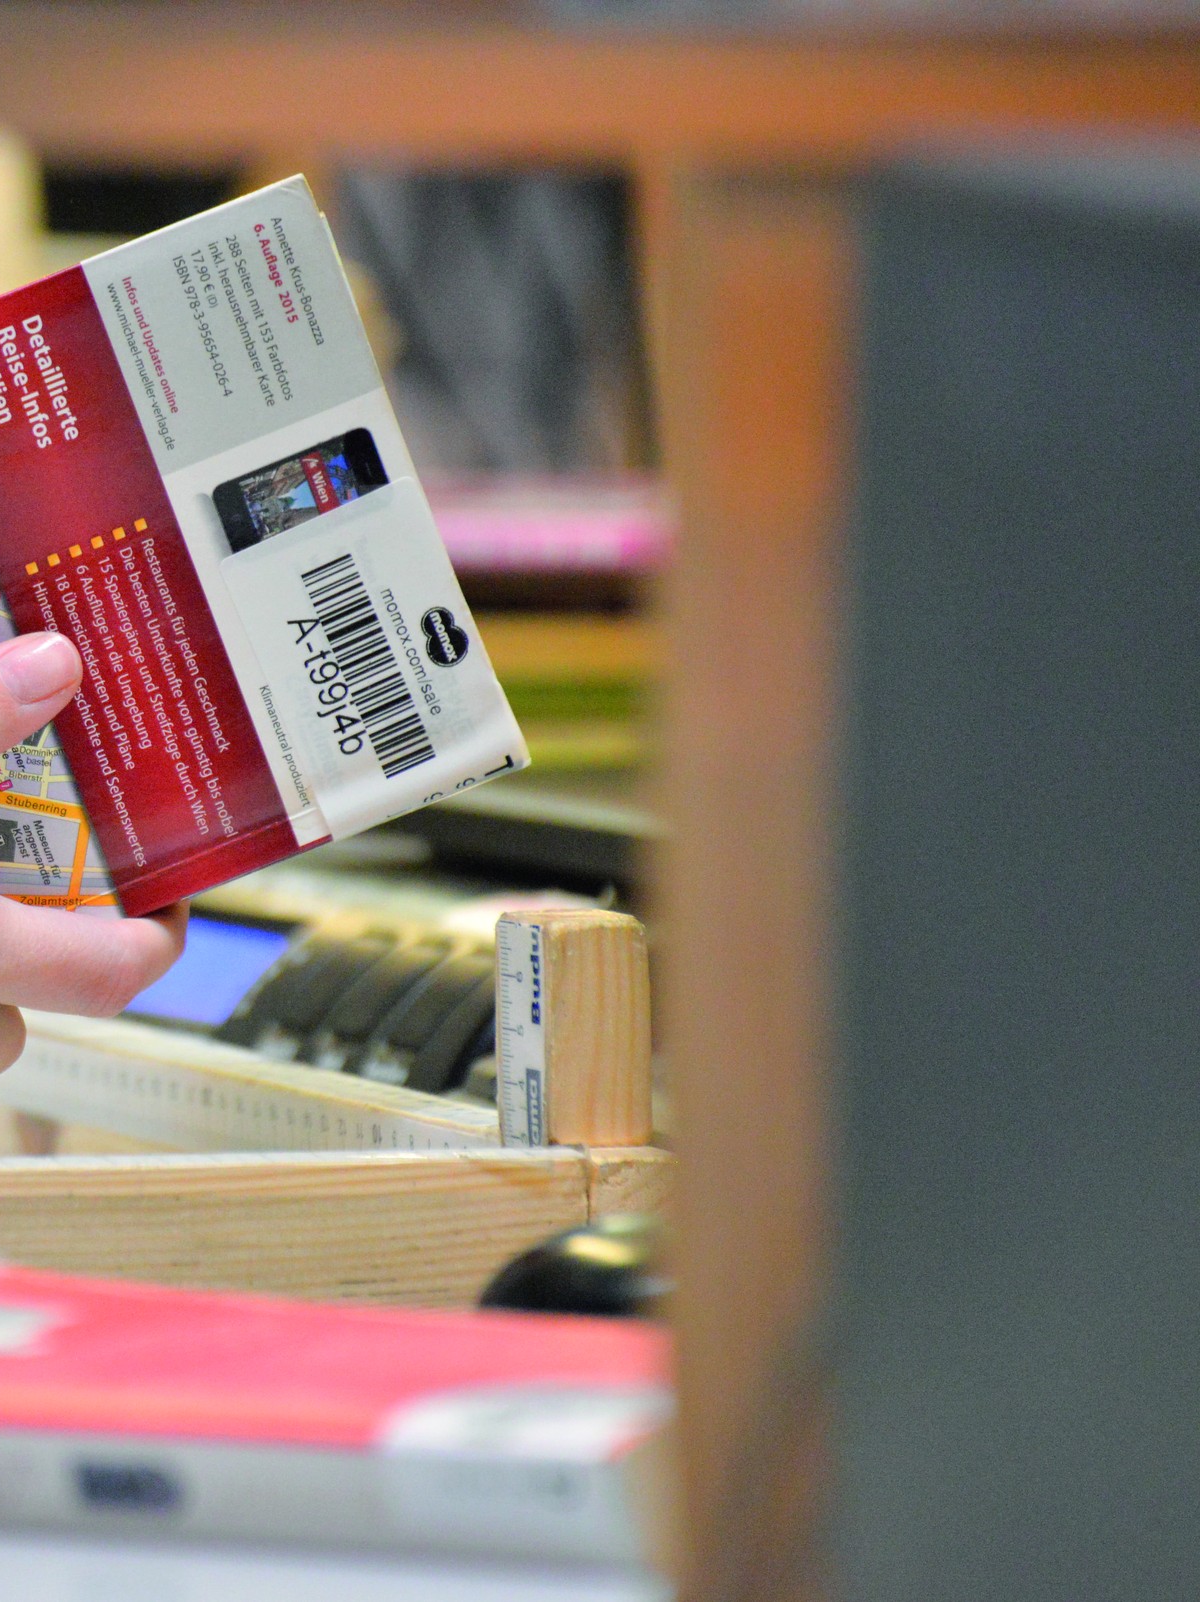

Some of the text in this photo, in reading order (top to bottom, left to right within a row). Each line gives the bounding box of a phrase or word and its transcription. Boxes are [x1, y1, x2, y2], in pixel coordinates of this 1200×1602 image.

[172, 255, 233, 398] ISBN 978-3-95654-026-4
[190, 249, 218, 308] 17,90 € (D)
[207, 241, 275, 408] inkl. herausnehmbarer Karte
[225, 235, 293, 402] 288 Seiten mit 153 Farbfotos
[253, 223, 299, 324] 6. Auflage 2015
[271, 217, 325, 346] Annette Krus-Bonazza
[22, 314, 79, 442] Detaillierte
[107, 283, 175, 451] www.michael-mueller-verlag.de
[121, 276, 179, 414] Infos und Updates online
[311, 470, 329, 503] Wien
[55, 574, 135, 770] 18 Übersichtskarten und Pläne
[76, 565, 152, 750] 6 Ausflüge in die Umgebung
[98, 556, 210, 835] 15 Spaziergänge und Streifzüge durch Wien
[119, 547, 239, 839] Die besten Unterkünfte von günstig bis nobel
[142, 537, 230, 753] Restaurants für jeden Geschmack
[287, 616, 364, 755] A-t99j4b
[380, 587, 442, 716] momox.com/sale
[429, 611, 458, 662] momox
[26, 756, 52, 767] bastei
[32, 581, 147, 868] Hinterg eschichte und Sehenswertes
[259, 685, 311, 808] Klimaneutral produziert
[5, 795, 68, 818] Stubenring
[11, 827, 31, 859] Kunst
[22, 824, 51, 887] angewandte
[32, 819, 62, 880] Museum für
[20, 896, 87, 906] Zollamtsstr.
